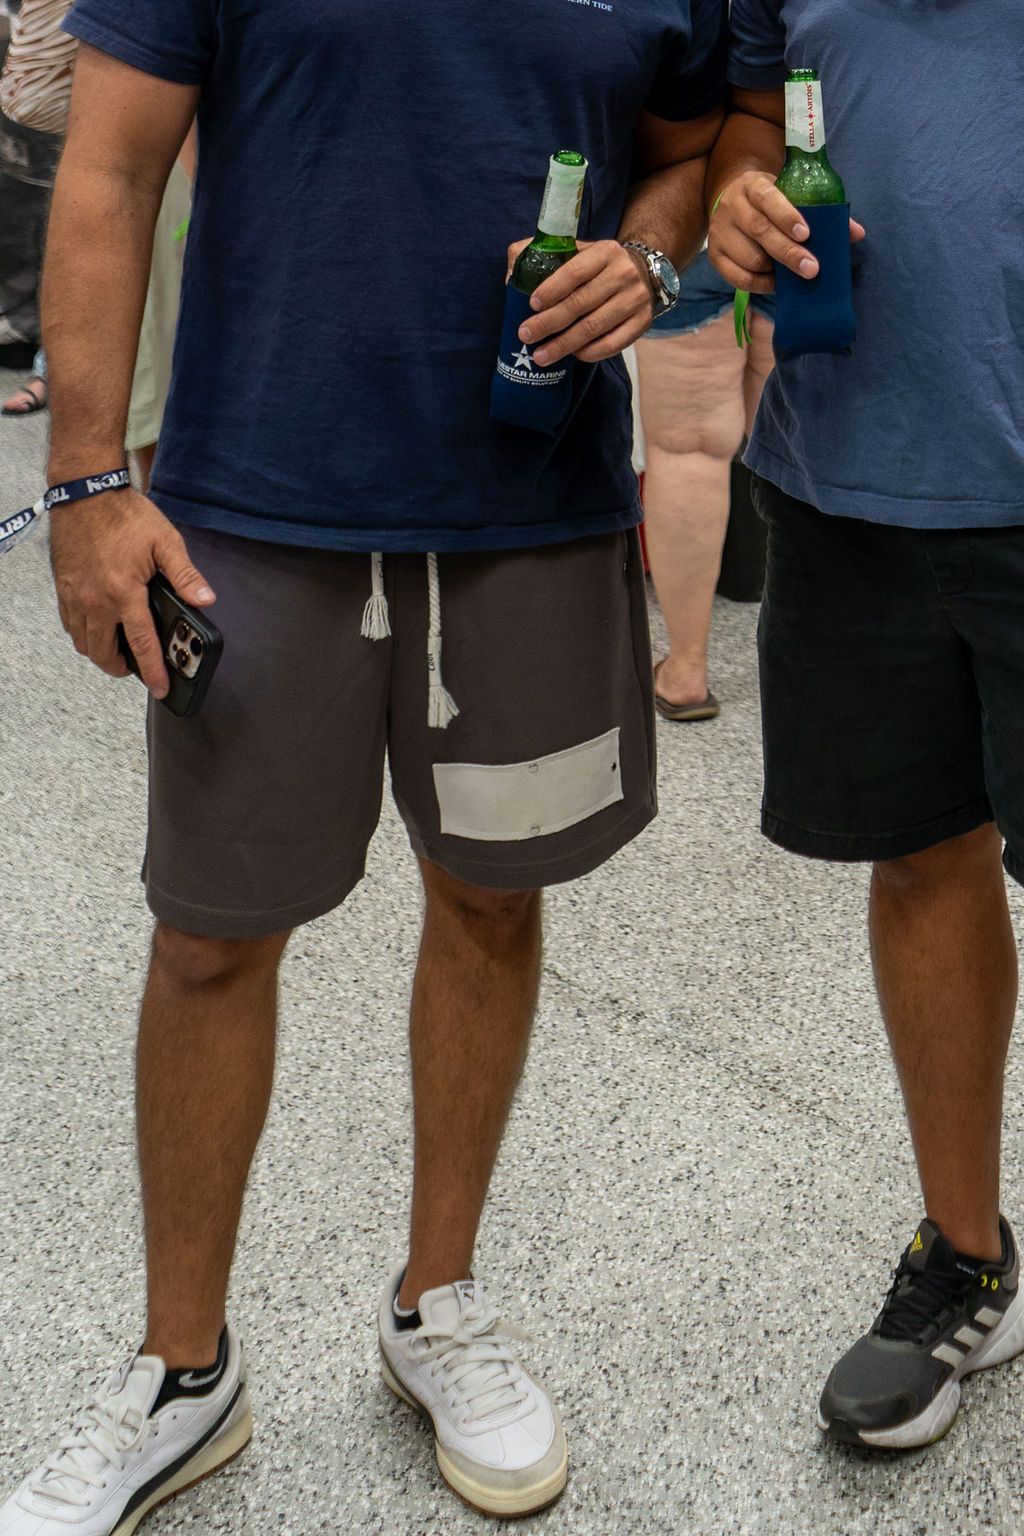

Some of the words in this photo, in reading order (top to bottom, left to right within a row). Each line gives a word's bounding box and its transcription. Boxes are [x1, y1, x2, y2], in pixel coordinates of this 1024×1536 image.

[592, 0, 613, 12] TIDE
[806, 84, 814, 112] ARTOIS
[808, 121, 816, 148] STELLA
